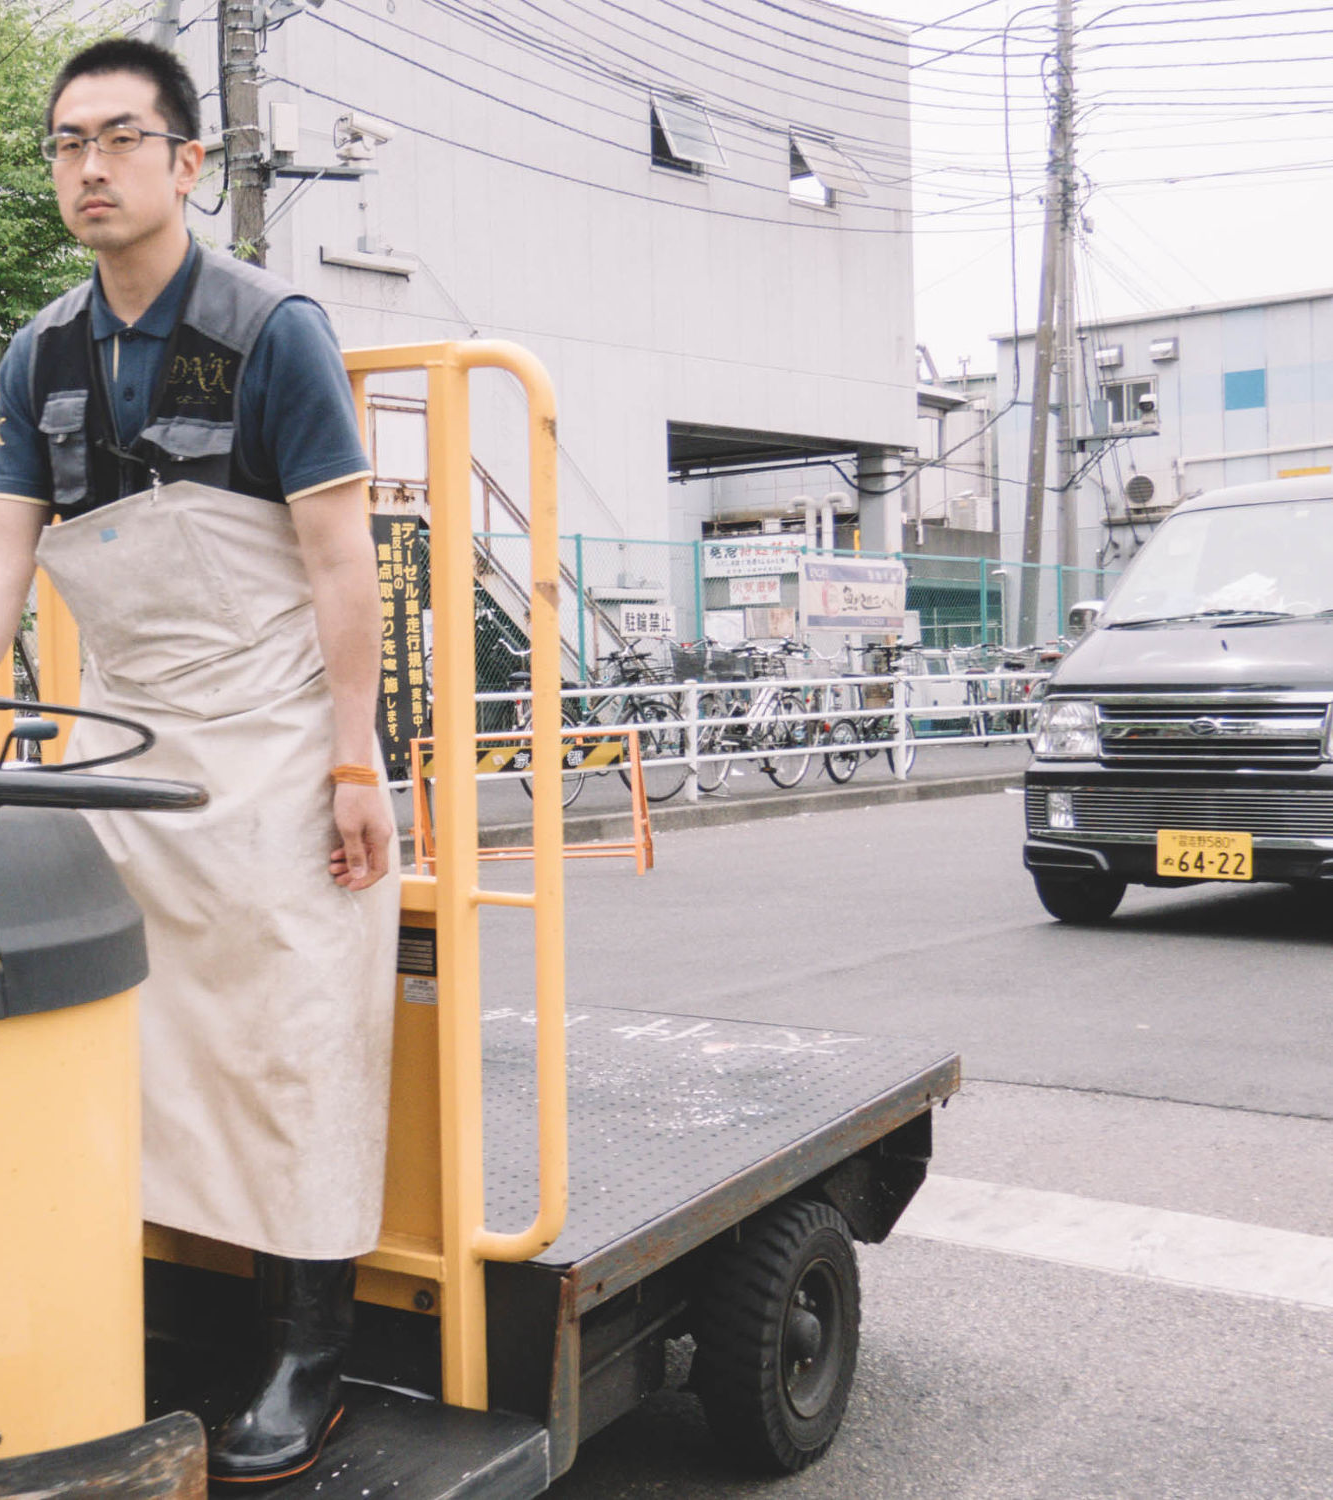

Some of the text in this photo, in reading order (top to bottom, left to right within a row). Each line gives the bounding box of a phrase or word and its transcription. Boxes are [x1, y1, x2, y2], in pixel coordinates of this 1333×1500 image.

[391, 522, 404, 590] 違反車両の
[625, 612, 671, 632] 駐輪禁止
[1178, 851, 1245, 875] 64-22
